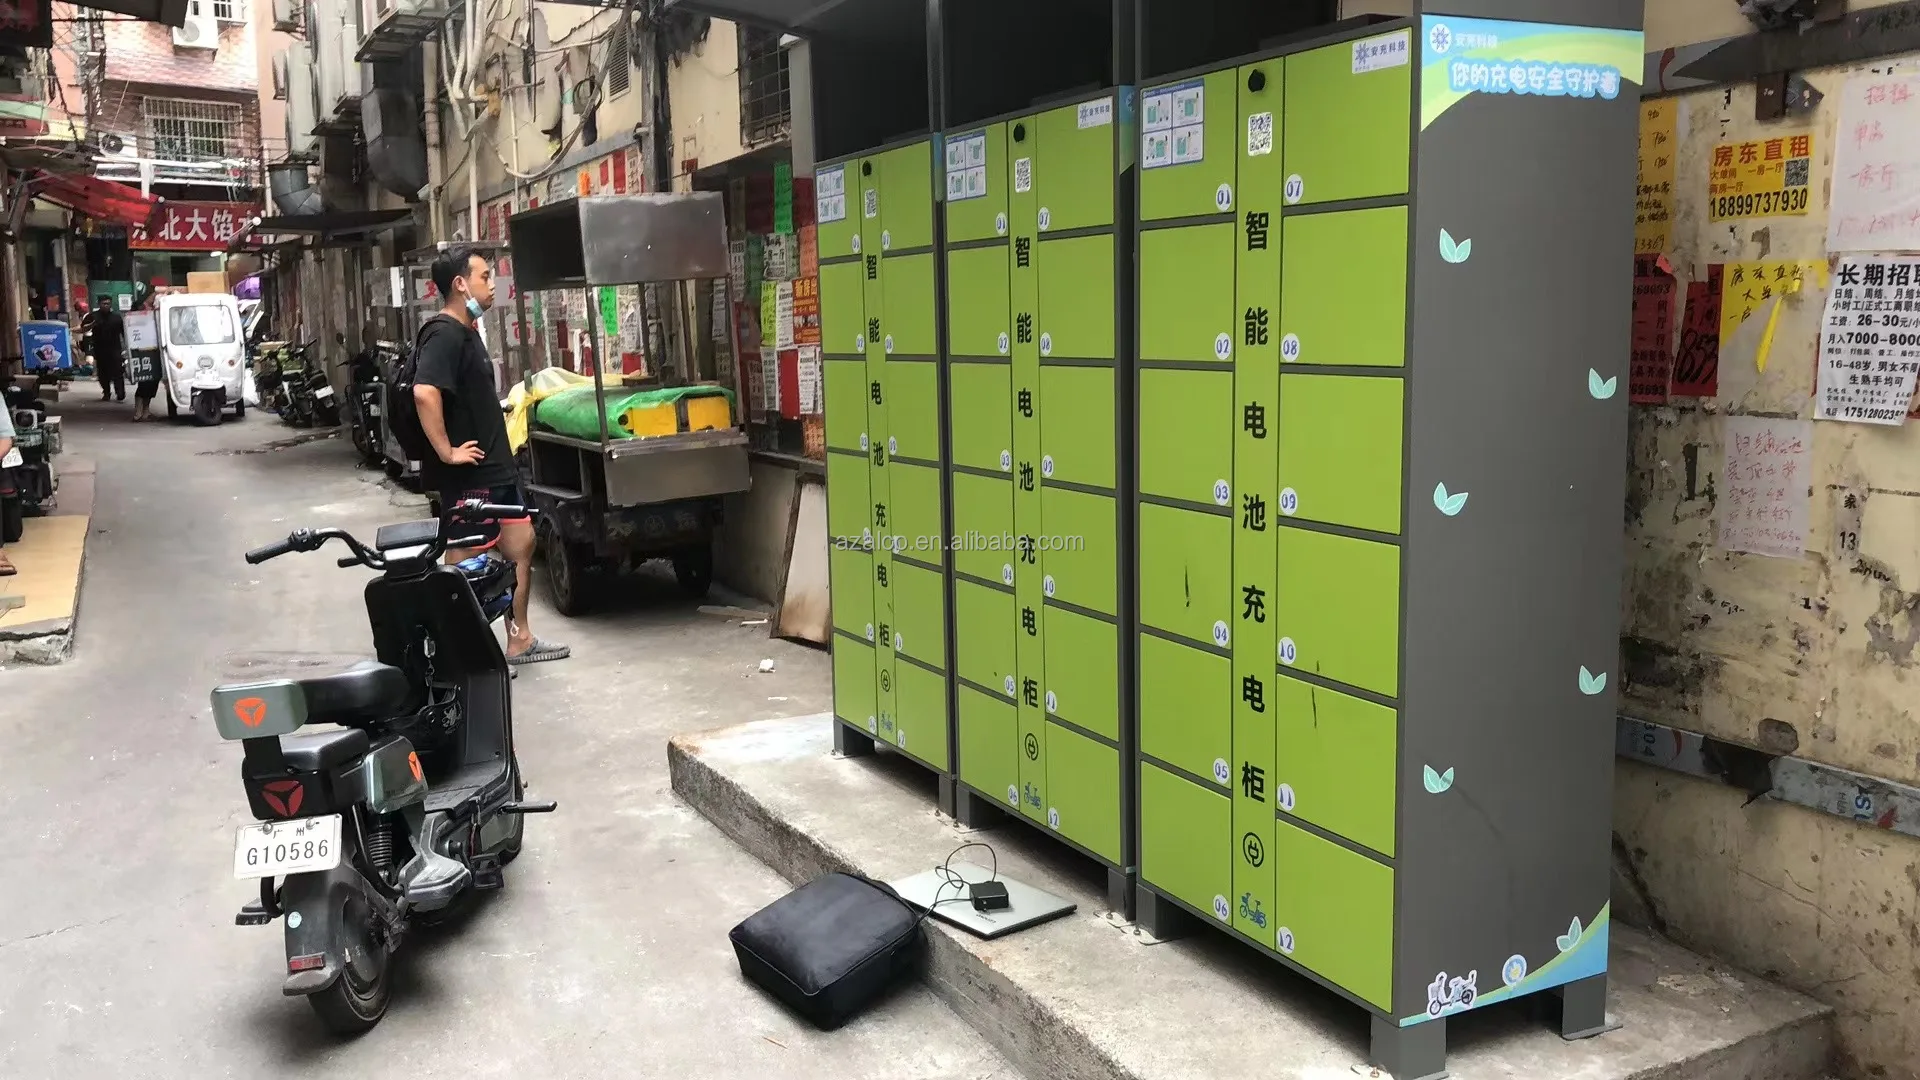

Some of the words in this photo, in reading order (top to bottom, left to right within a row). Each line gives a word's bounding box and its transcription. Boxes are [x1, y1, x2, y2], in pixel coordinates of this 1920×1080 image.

[1452, 61, 1618, 94] 你的充电安全守护者
[1714, 135, 1809, 167] 房东直租
[1217, 190, 1231, 205] 01
[1286, 181, 1302, 198] 07
[1710, 187, 1808, 218] 18899737930
[132, 208, 275, 244] 北大馅
[1216, 339, 1229, 354] 02
[1283, 340, 1297, 355] 08
[1849, 374, 1904, 387] 生熟手均可
[866, 254, 890, 647] 智能电池充电柜
[1014, 236, 1039, 708] 智能电池充电柜
[1215, 486, 1229, 500] 03
[1281, 494, 1296, 509] 09
[1242, 211, 1269, 804] 智能电池充电柜
[1214, 626, 1227, 640] 04
[1280, 642, 1295, 660] 10
[1214, 763, 1228, 779] 05
[1279, 788, 1292, 807] 11
[247, 839, 328, 866] G10586
[1214, 898, 1228, 917] 06
[1279, 932, 1293, 950] 12
